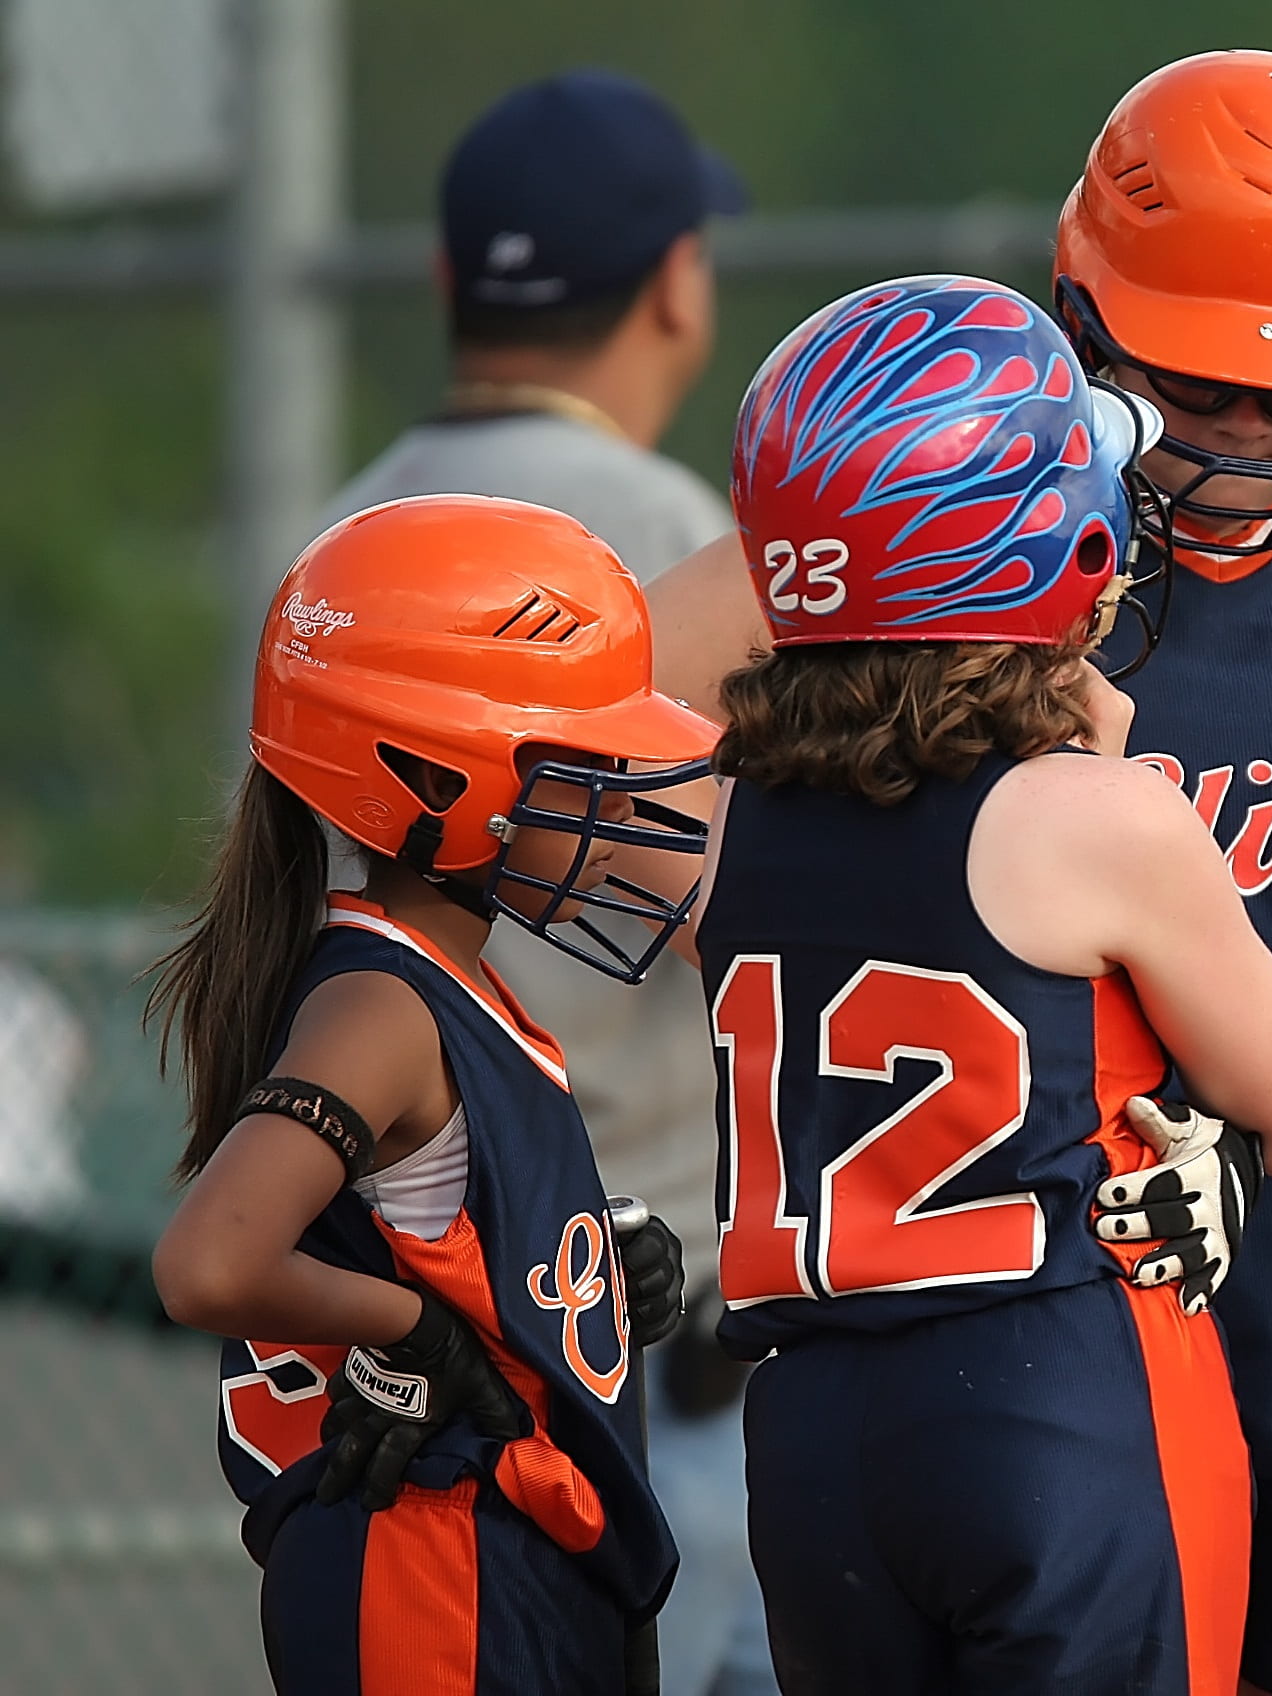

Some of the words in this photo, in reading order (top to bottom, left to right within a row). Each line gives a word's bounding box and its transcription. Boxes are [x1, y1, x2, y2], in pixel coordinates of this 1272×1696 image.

[282, 591, 356, 637] Rawlings
[764, 538, 850, 614] 23
[711, 953, 1047, 1311] 12
